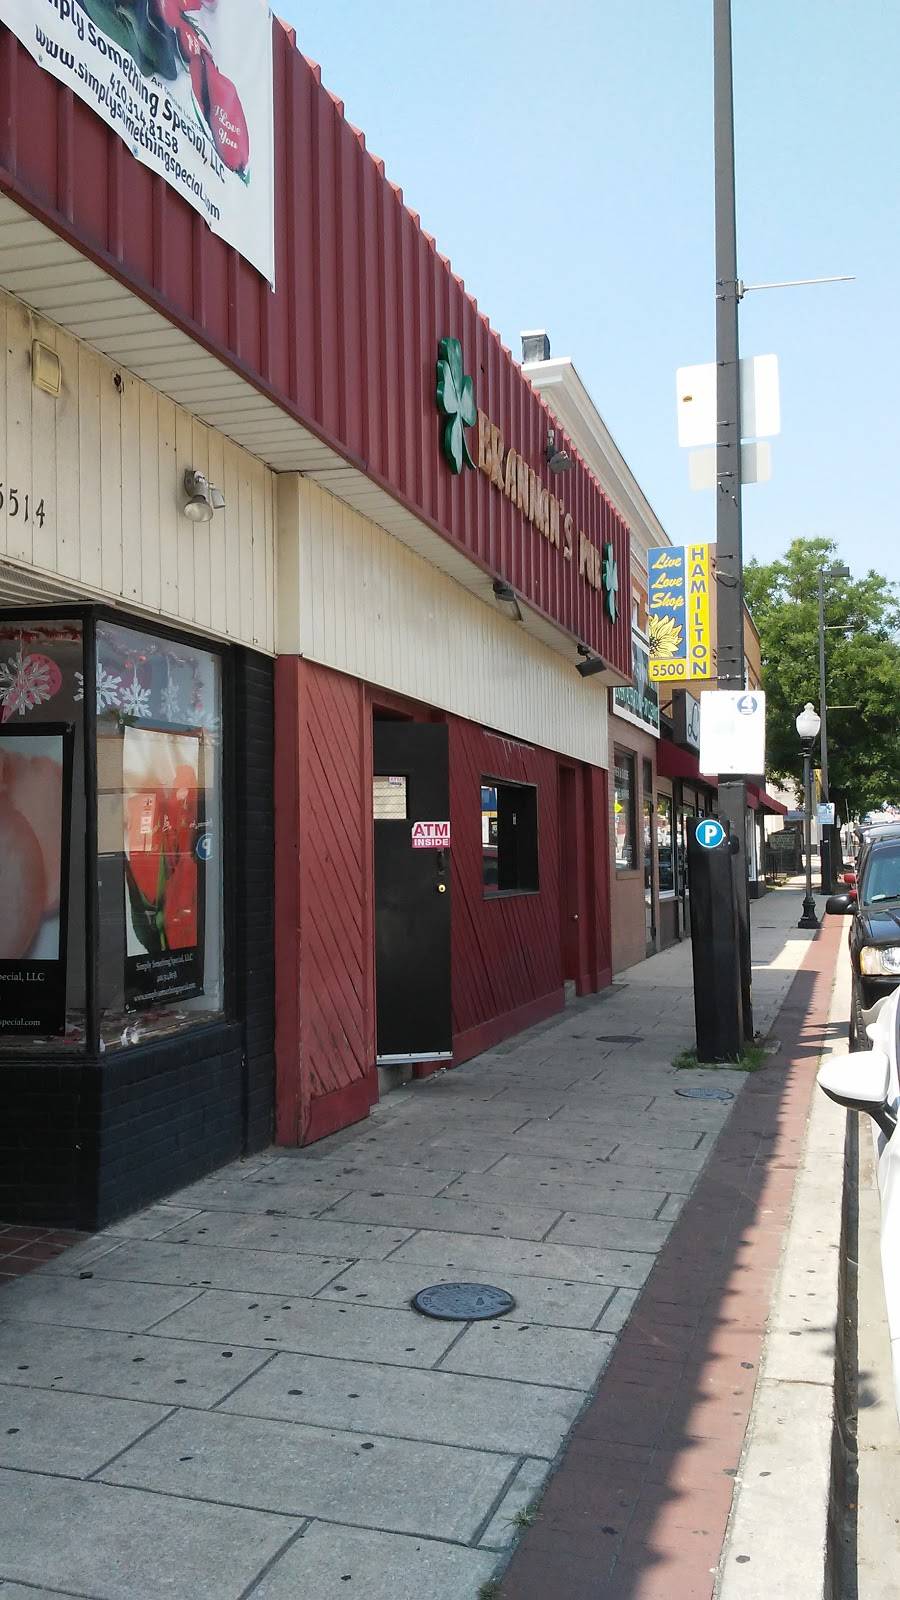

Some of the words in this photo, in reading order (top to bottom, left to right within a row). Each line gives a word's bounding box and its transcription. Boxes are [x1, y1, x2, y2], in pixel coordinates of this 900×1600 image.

[87, 22, 160, 118] Something
[162, 99, 208, 165] Special,
[210, 150, 225, 184] LLC
[219, 128, 239, 149] You
[652, 553, 682, 569] Live
[651, 572, 683, 589] Love
[650, 592, 684, 611] Shop
[690, 547, 707, 675] HAMILTON
[652, 663, 685, 676] 5500
[413, 823, 448, 836] ATM
[704, 824, 718, 844] P
[414, 838, 449, 846] INSIDE
[26, 972, 45, 982] LLC
